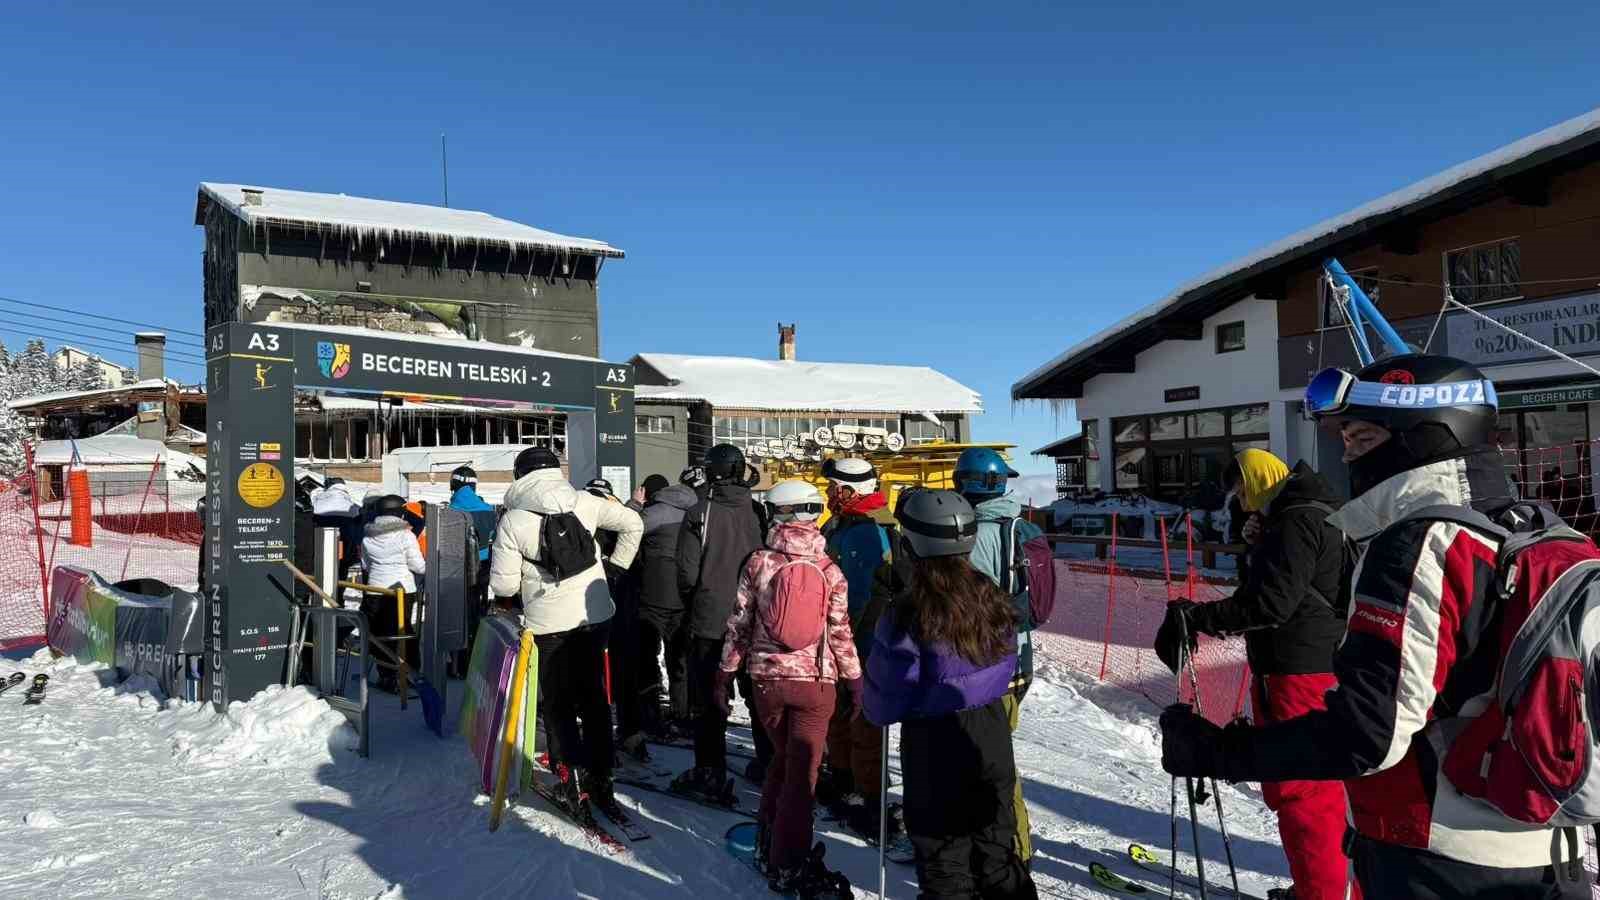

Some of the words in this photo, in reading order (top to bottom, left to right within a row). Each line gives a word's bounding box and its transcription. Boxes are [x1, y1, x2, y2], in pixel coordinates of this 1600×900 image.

[248, 333, 280, 351] A3
[362, 353, 452, 378] BECEREN
[457, 363, 527, 385] TELESKİ
[541, 371, 551, 387] 2
[606, 369, 626, 383] A3
[212, 584, 222, 705] BECEREN
